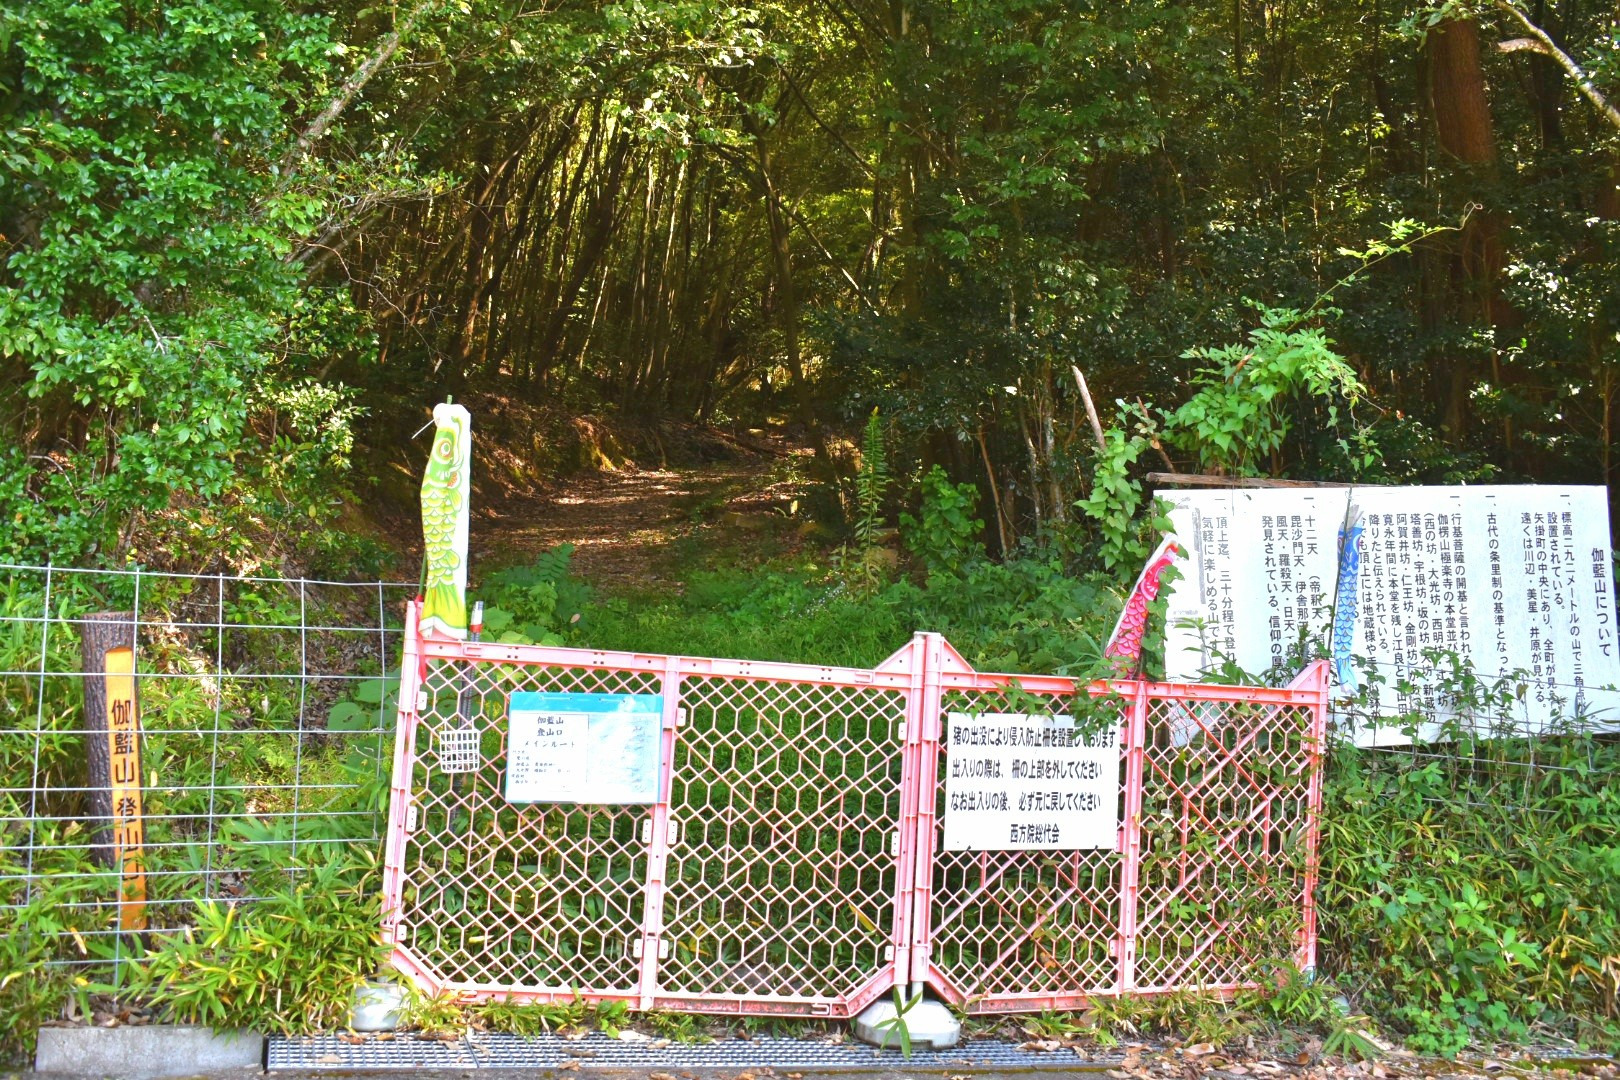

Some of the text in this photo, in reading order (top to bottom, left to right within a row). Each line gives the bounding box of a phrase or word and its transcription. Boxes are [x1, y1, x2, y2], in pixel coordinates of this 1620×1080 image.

[1546, 512, 1565, 609] 設置されている。
[1368, 514, 1390, 654] 降りたと伝えられている。
[1591, 547, 1611, 657] 伽藍山について
[536, 727, 563, 737] 登山口
[951, 758, 1103, 780] 出入りの際は、柵の上部を外してください
[950, 791, 1102, 812] なお出入りの後、必ず元に戻してください
[1009, 823, 1060, 844] 西方院総代会
